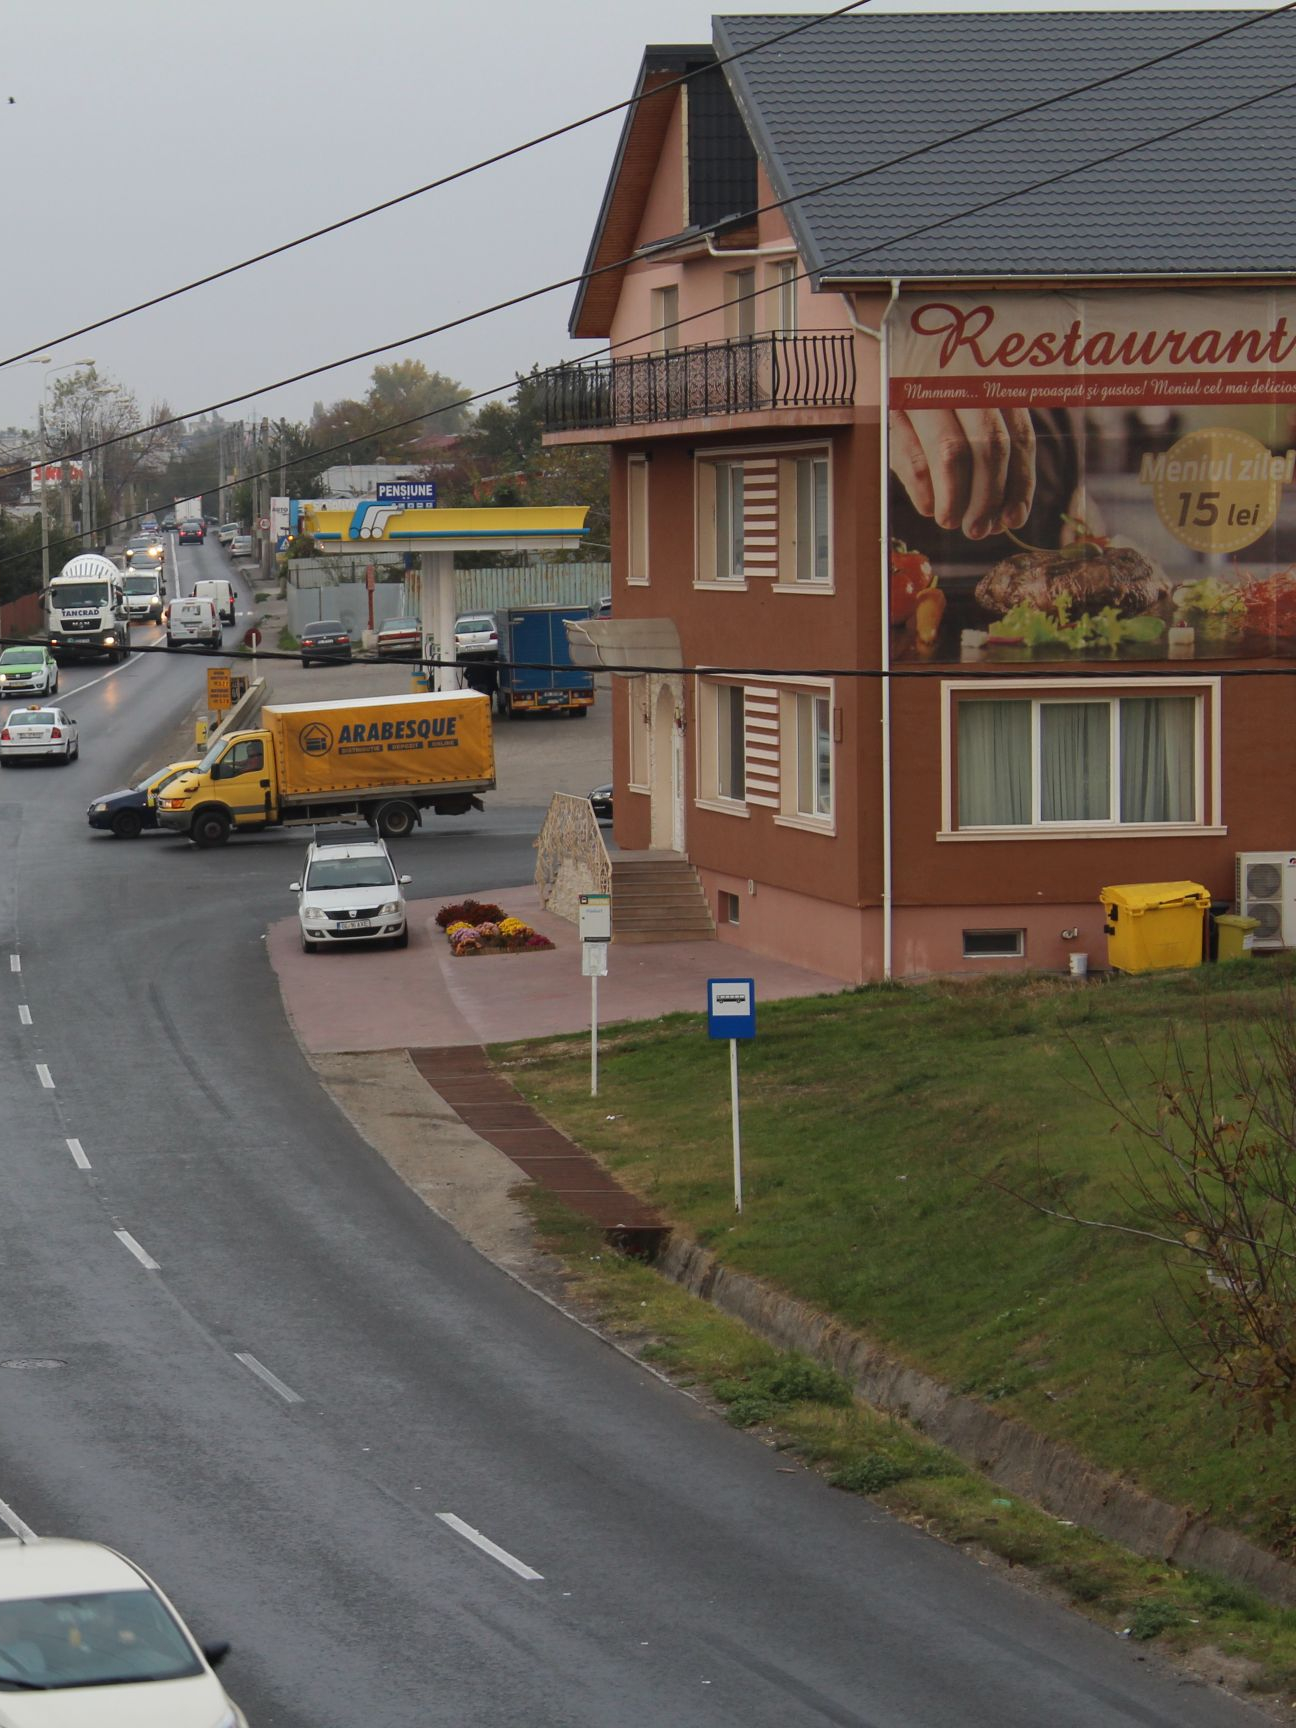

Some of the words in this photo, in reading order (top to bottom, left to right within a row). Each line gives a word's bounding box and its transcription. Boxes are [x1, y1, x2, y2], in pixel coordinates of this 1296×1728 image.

[910, 303, 1296, 369] Restaurant
[983, 382, 1027, 397] Mereu
[1102, 380, 1147, 401] gustos!
[1151, 378, 1200, 395] Meniul
[1205, 378, 1222, 394] cel
[1225, 380, 1249, 393] mai
[1140, 452, 1232, 483] Meniul
[1237, 449, 1296, 483] zilei
[379, 485, 433, 496] PENSIUNE
[1178, 492, 1220, 527] 15
[1227, 503, 1260, 526] lei
[62, 609, 100, 617] TANCRAD
[338, 717, 457, 744] ARABESQUE
